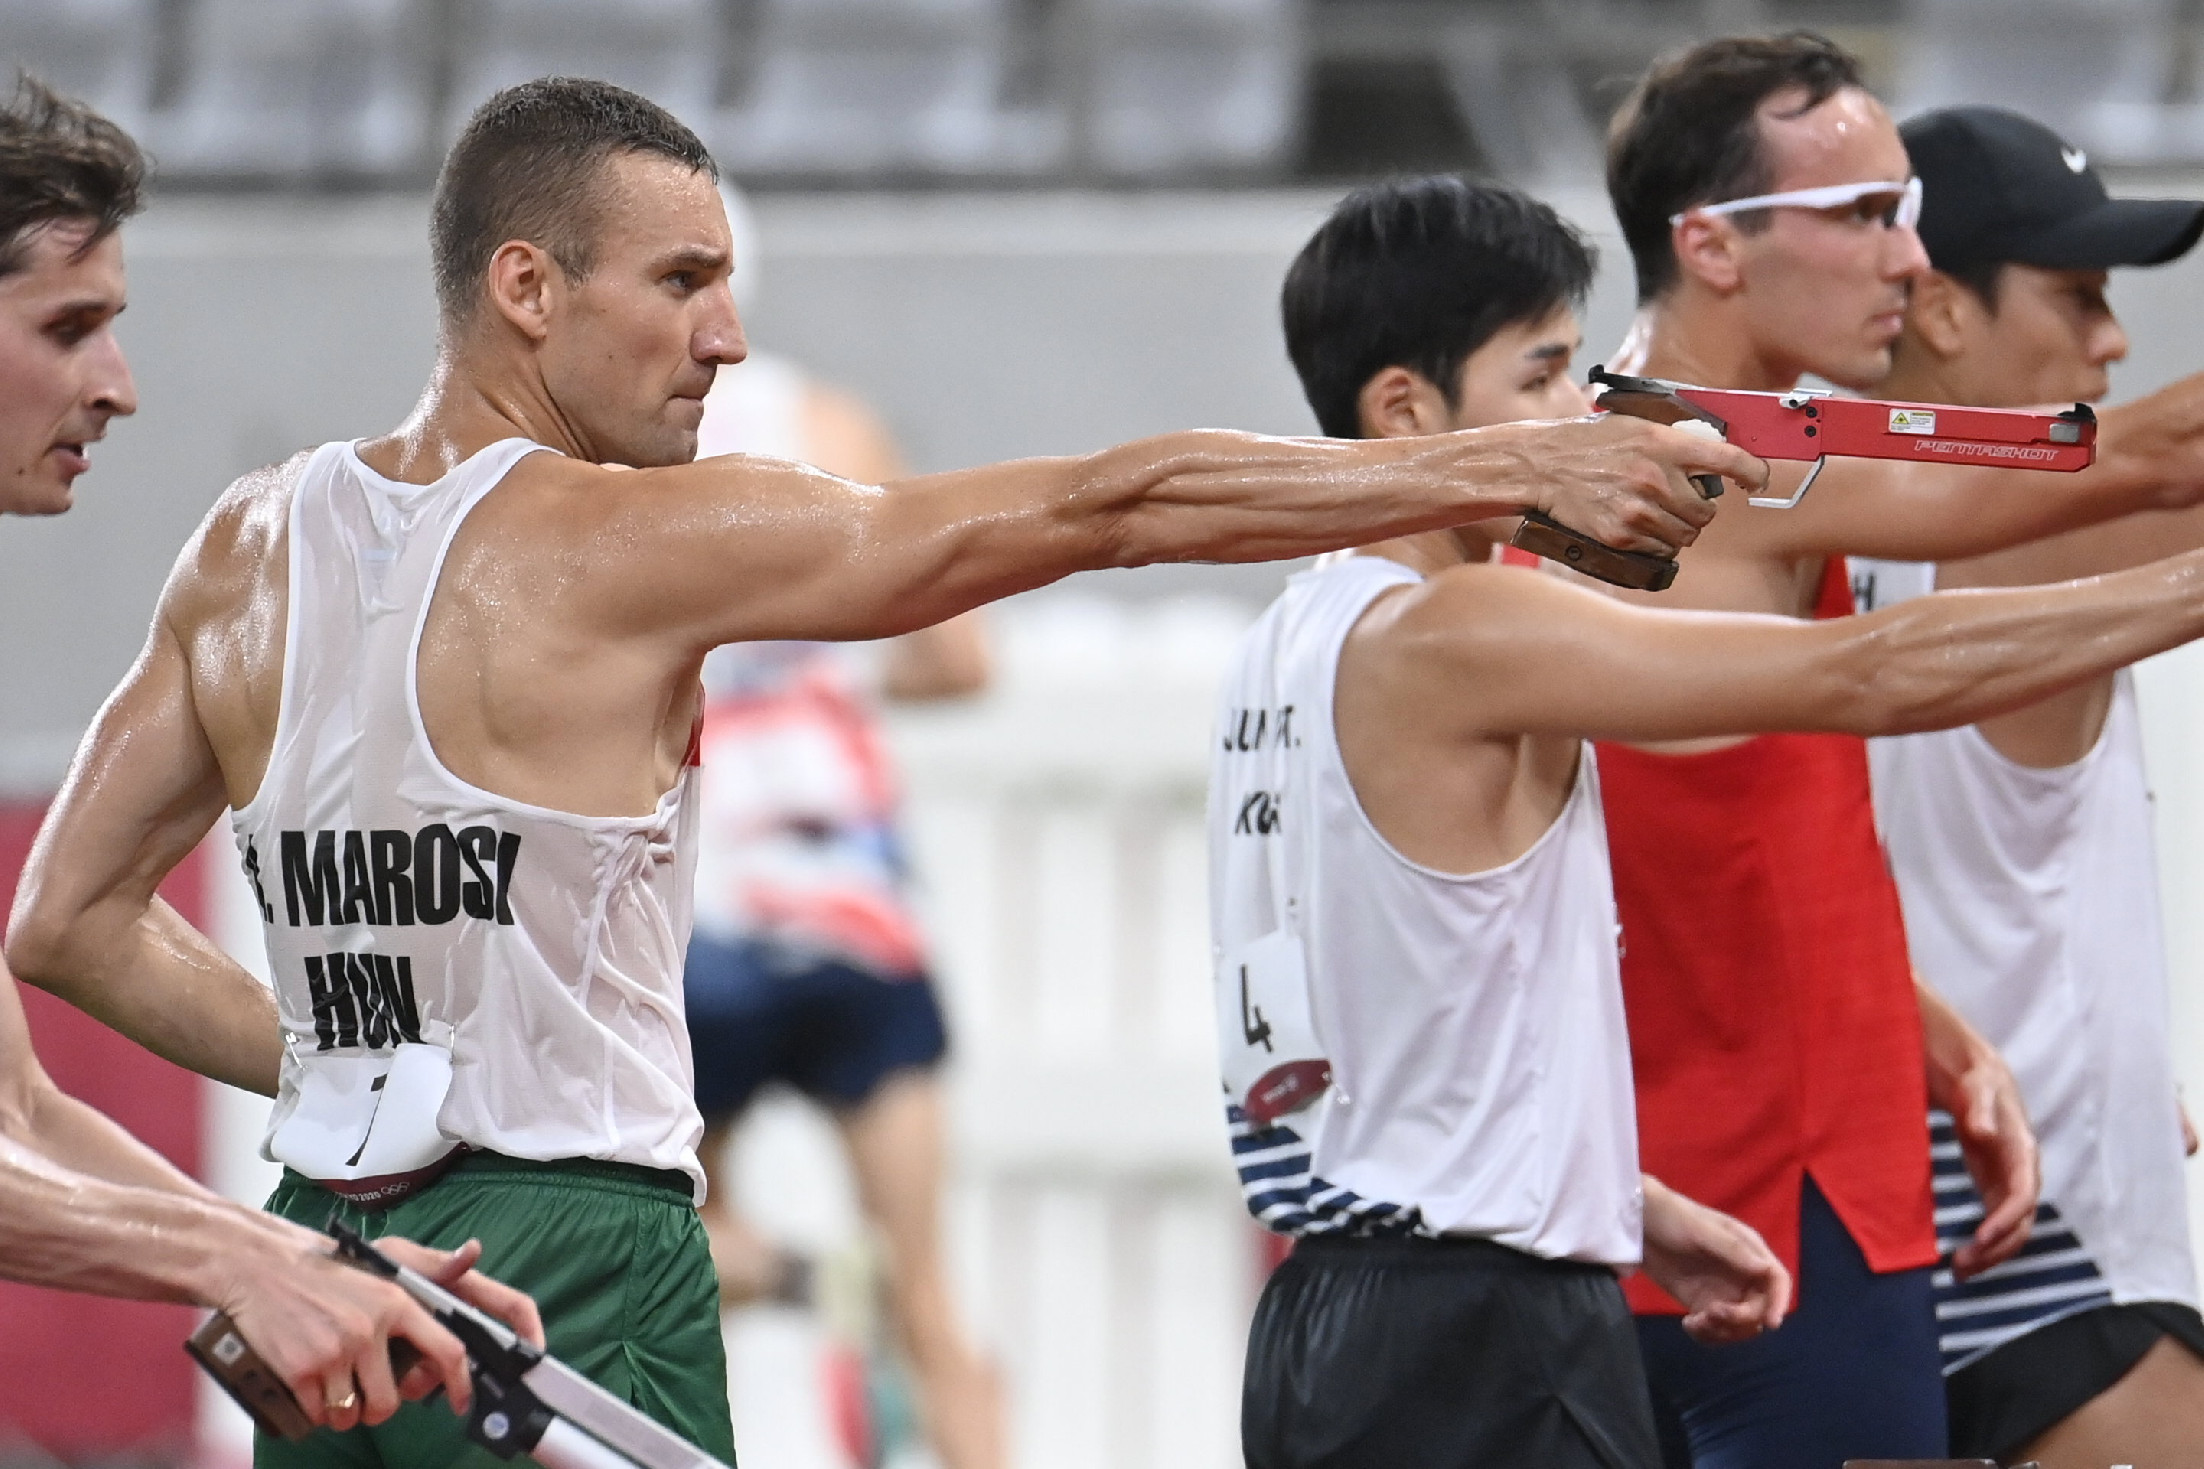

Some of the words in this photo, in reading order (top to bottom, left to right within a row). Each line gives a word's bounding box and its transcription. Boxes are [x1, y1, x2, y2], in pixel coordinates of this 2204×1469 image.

[1914, 440, 2059, 460] PENTASHOT
[280, 823, 522, 927] MAROSI
[1240, 964, 1272, 1052] 4
